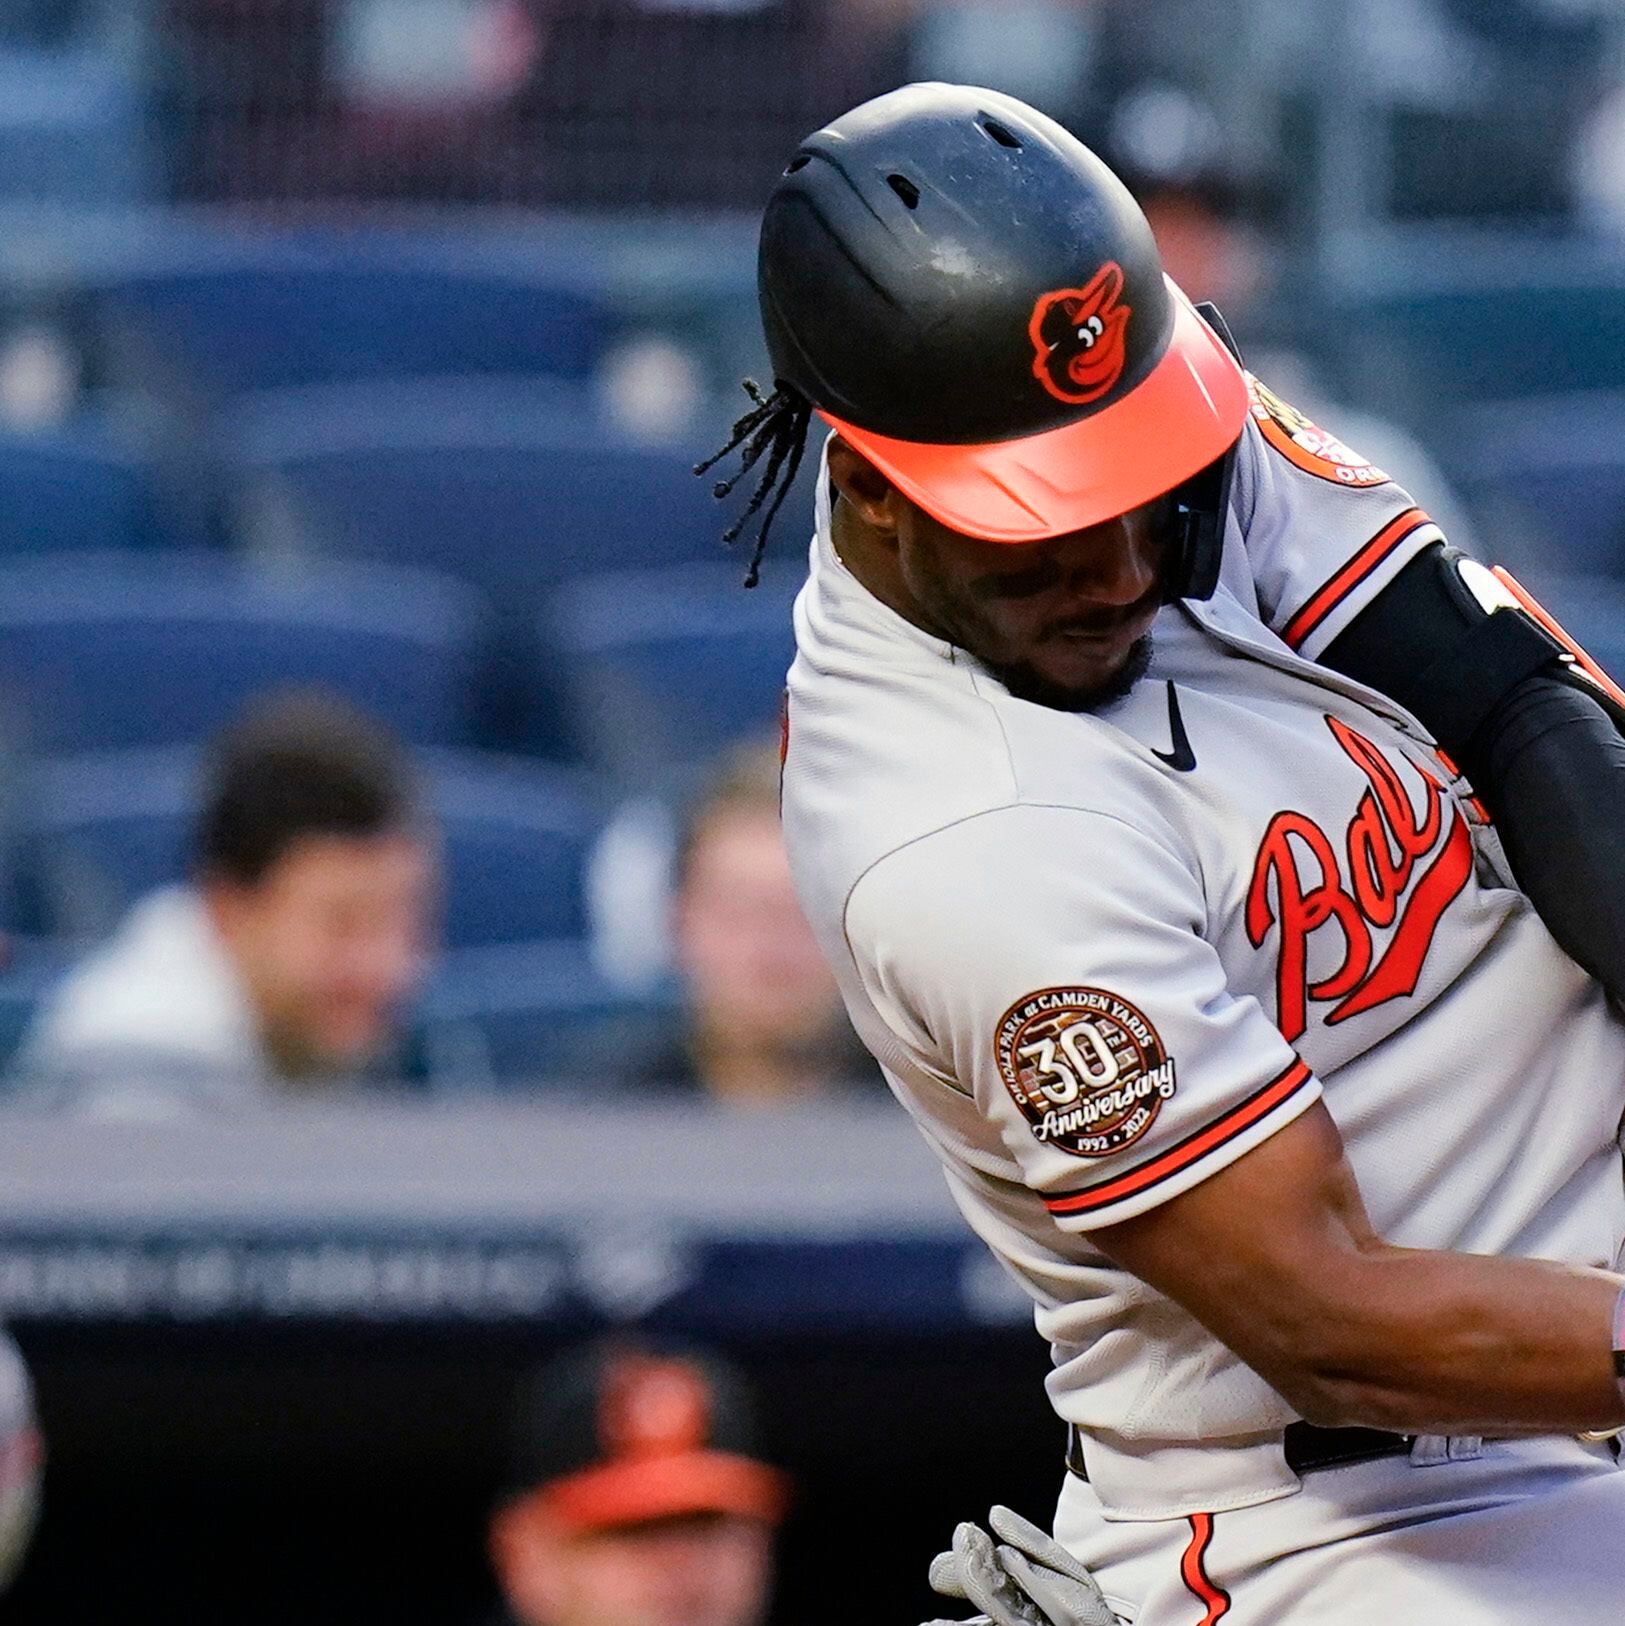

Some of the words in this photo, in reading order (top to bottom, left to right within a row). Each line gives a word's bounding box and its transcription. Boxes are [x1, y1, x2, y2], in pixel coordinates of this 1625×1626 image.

[1001, 1013, 1025, 1049] PARK
[1023, 1001, 1039, 1019] at
[1038, 992, 1110, 1011] CAMDEN
[1110, 1001, 1154, 1047] YARDS
[1018, 1022, 1119, 1104] 30
[1032, 1058, 1175, 1141] Anniversary
[1077, 1136, 1109, 1151] 1992
[1120, 1107, 1150, 1139] 2022
